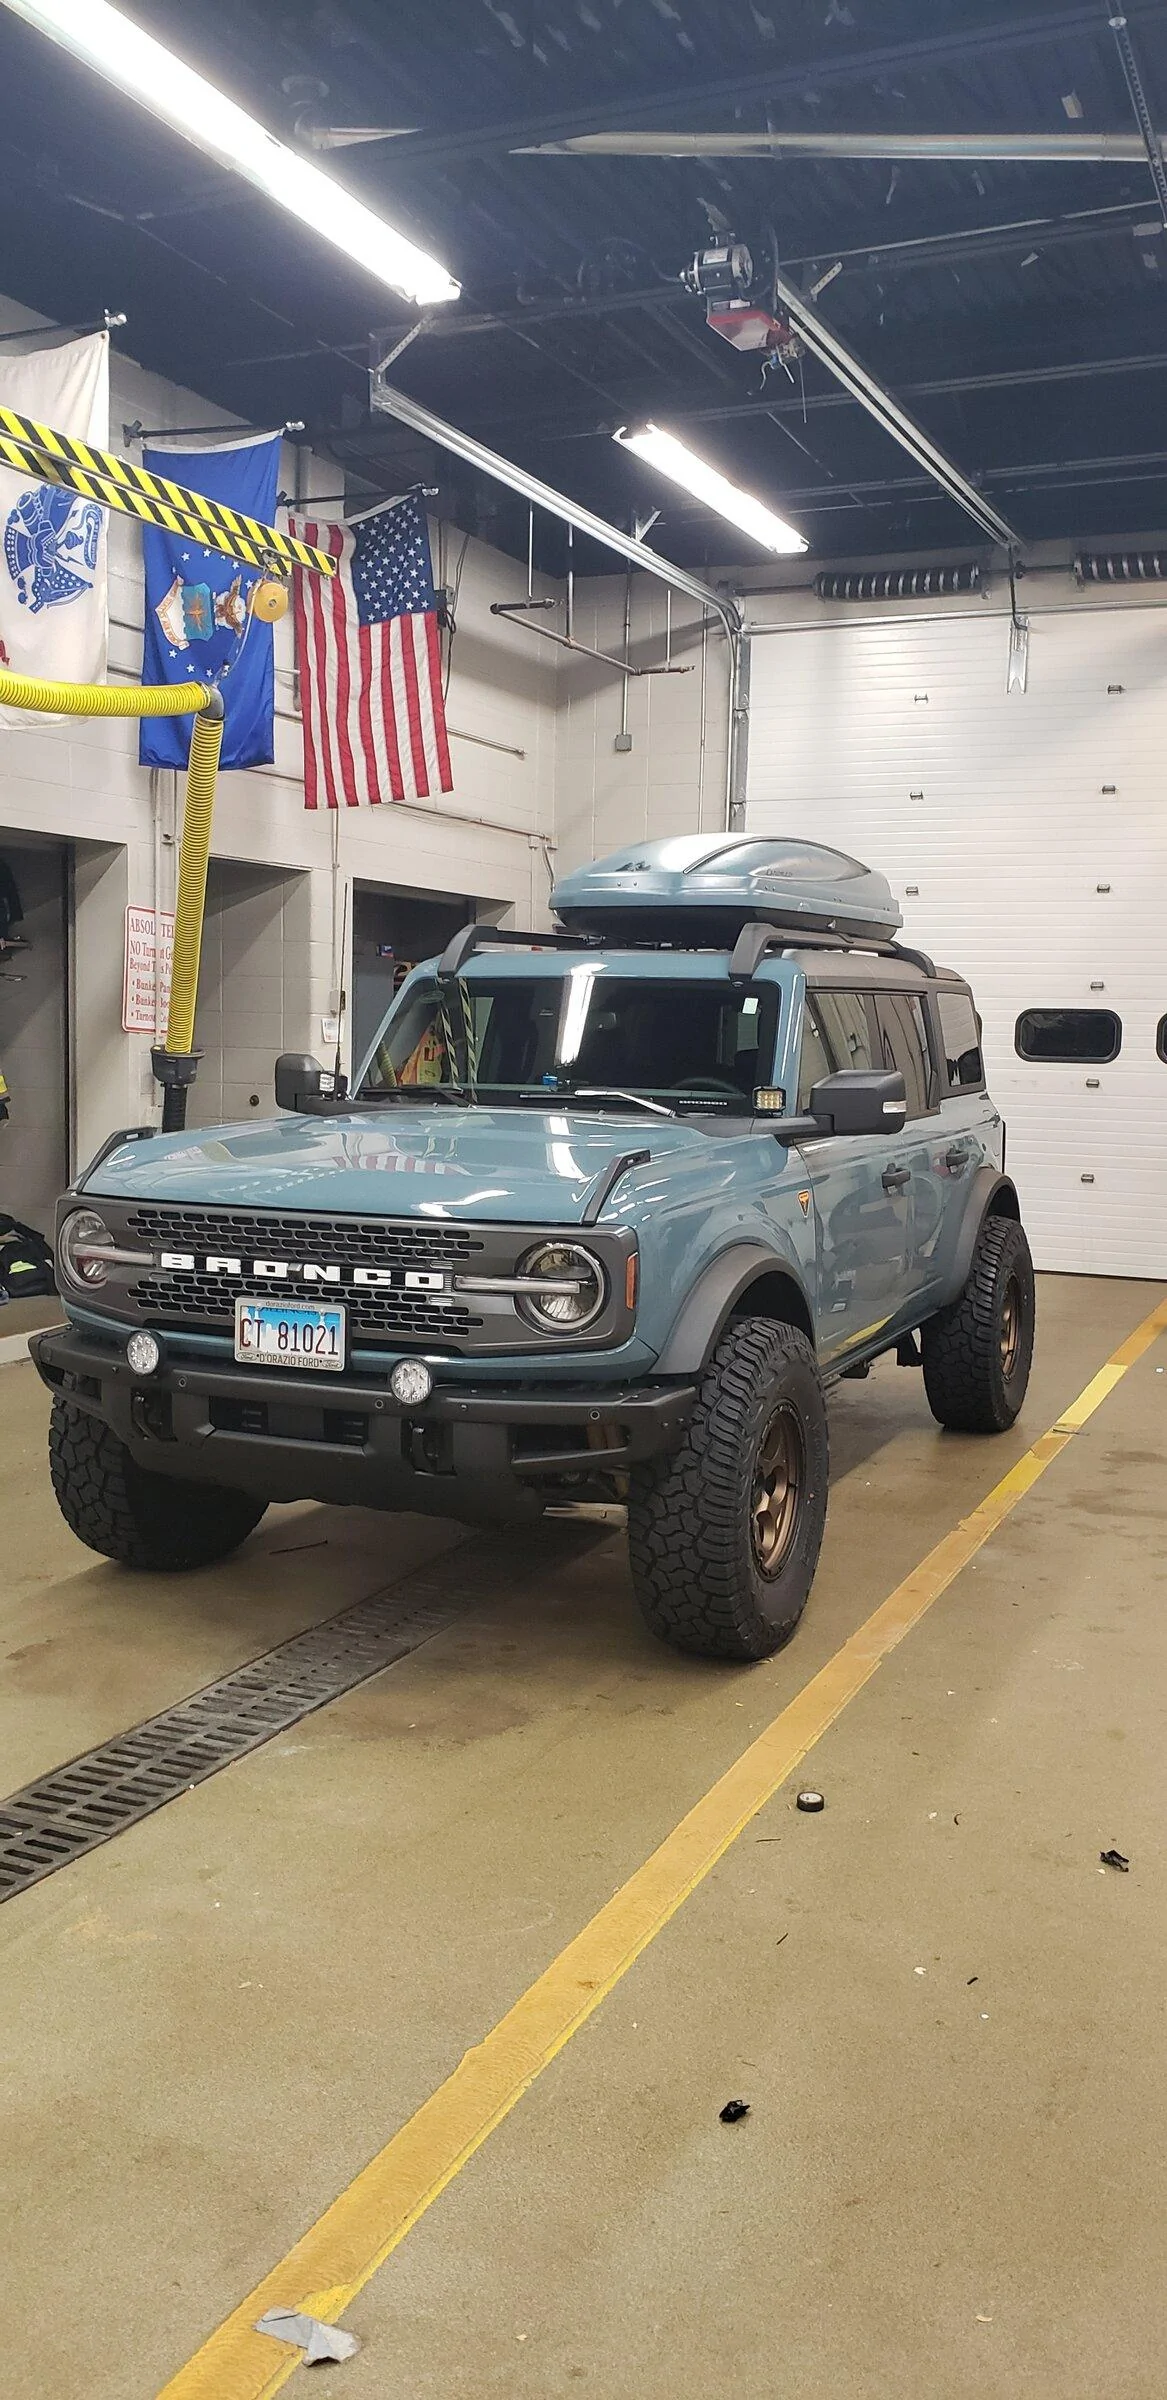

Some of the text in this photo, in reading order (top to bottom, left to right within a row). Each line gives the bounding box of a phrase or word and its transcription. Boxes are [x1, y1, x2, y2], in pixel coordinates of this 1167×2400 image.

[130, 917, 174, 939] ABSOLTE
[130, 940, 141, 956] NO
[130, 957, 151, 973] Beyond
[152, 960, 164, 974] Ts
[136, 978, 171, 993] Bunke Pan
[135, 994, 157, 1007] Bunke
[135, 1009, 157, 1022] Turno
[161, 1253, 444, 1290] BRONCO
[240, 1318, 339, 1355] CT 81021
[259, 1352, 319, 1368] D'ORAZIO FORD
